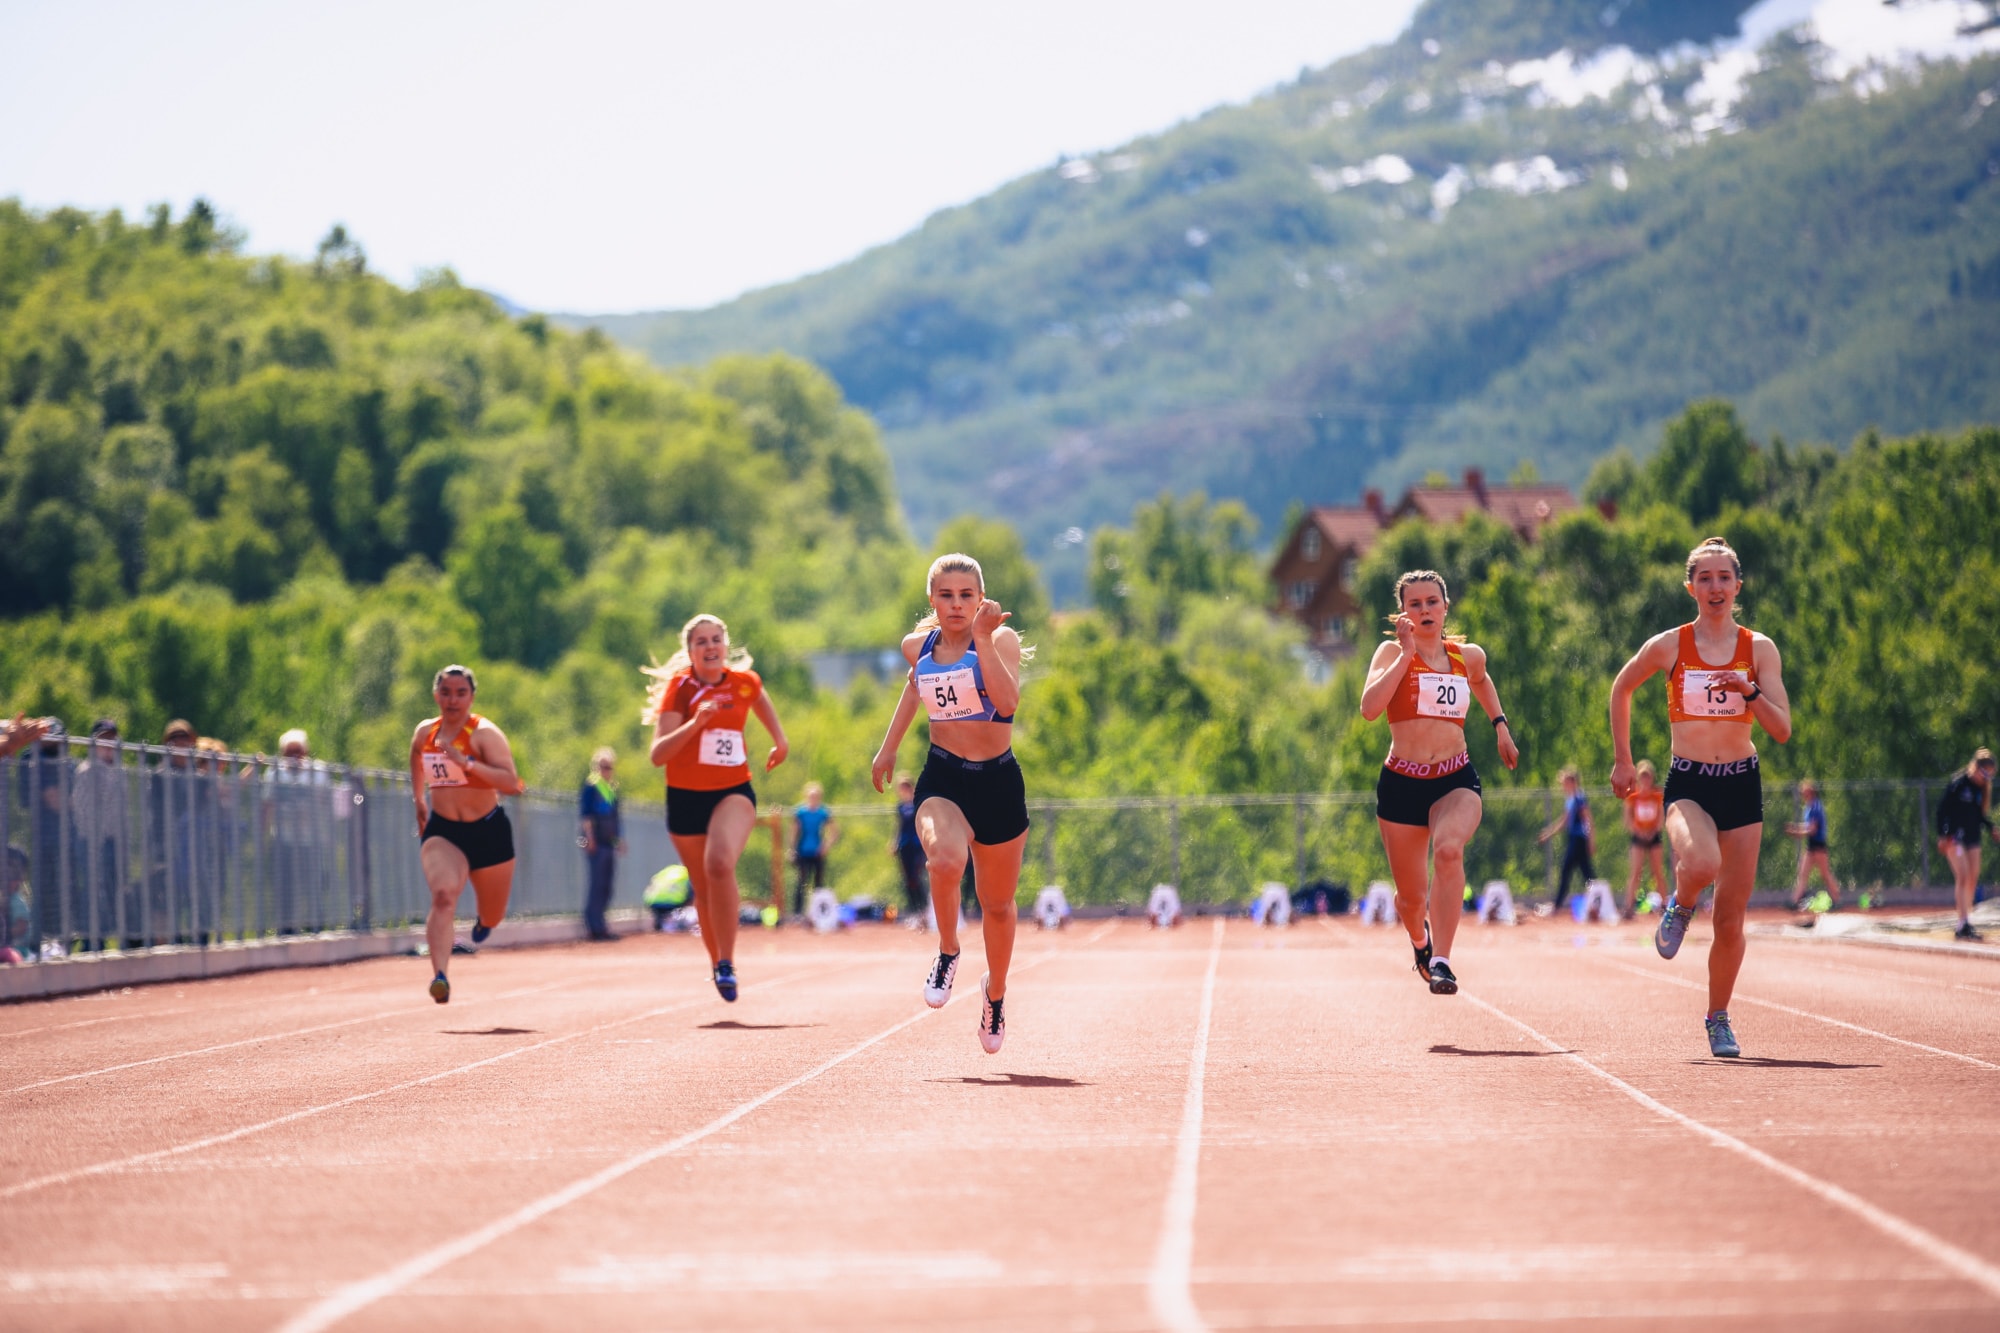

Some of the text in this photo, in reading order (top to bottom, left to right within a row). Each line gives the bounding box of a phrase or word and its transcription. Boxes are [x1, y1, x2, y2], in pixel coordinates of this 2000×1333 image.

[935, 685, 958, 708] 54
[1436, 685, 1456, 705] 20
[1704, 683, 1727, 704] 13
[953, 708, 972, 717] HIND
[716, 739, 733, 756] 29
[1394, 759, 1431, 776] PRO
[1437, 750, 1469, 775] NIKE
[1698, 758, 1748, 776] NIKE
[1751, 753, 1758, 769] P
